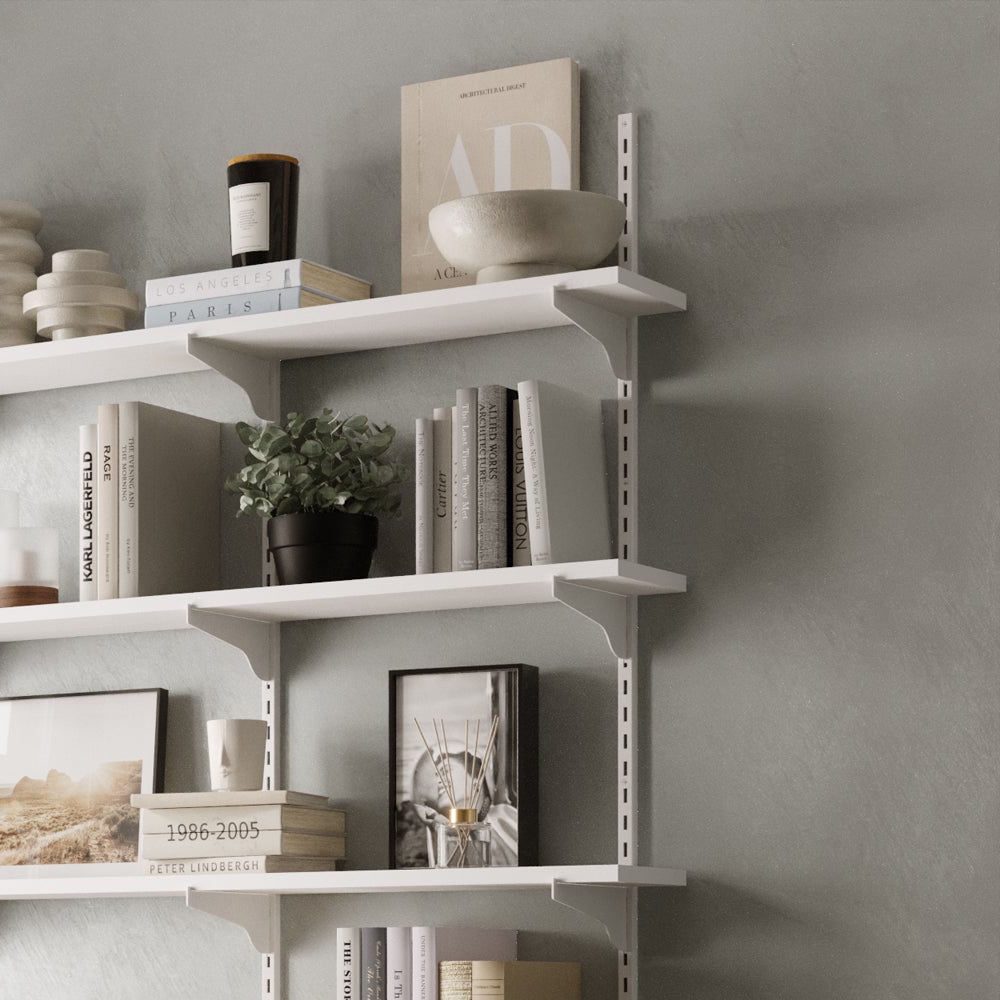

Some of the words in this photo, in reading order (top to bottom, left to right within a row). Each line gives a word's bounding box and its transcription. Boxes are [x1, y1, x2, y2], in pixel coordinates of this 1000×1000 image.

[459, 86, 505, 99] ARCHITECTURAL
[506, 82, 527, 92] DIGEST
[156, 283, 187, 297] LOS
[196, 270, 273, 291] ANGELES
[169, 301, 251, 323] PARIS
[462, 403, 470, 420] The
[488, 403, 498, 441] ALLIED
[462, 425, 470, 445] Last
[103, 445, 111, 481] RAGE
[462, 448, 470, 471] Time
[489, 443, 498, 480] WORKS
[83, 451, 93, 540] LAGERFELD
[436, 470, 447, 518] Cartier
[462, 474, 470, 499] They
[462, 501, 470, 519] Met
[515, 480, 528, 550] VUITTON
[83, 541, 93, 582] KARL
[167, 821, 260, 842] 1986-2005
[149, 863, 185, 874] PETER
[190, 861, 259, 873] LINDBERGH
[343, 940, 351, 966] THE
[394, 970, 403, 980] Is
